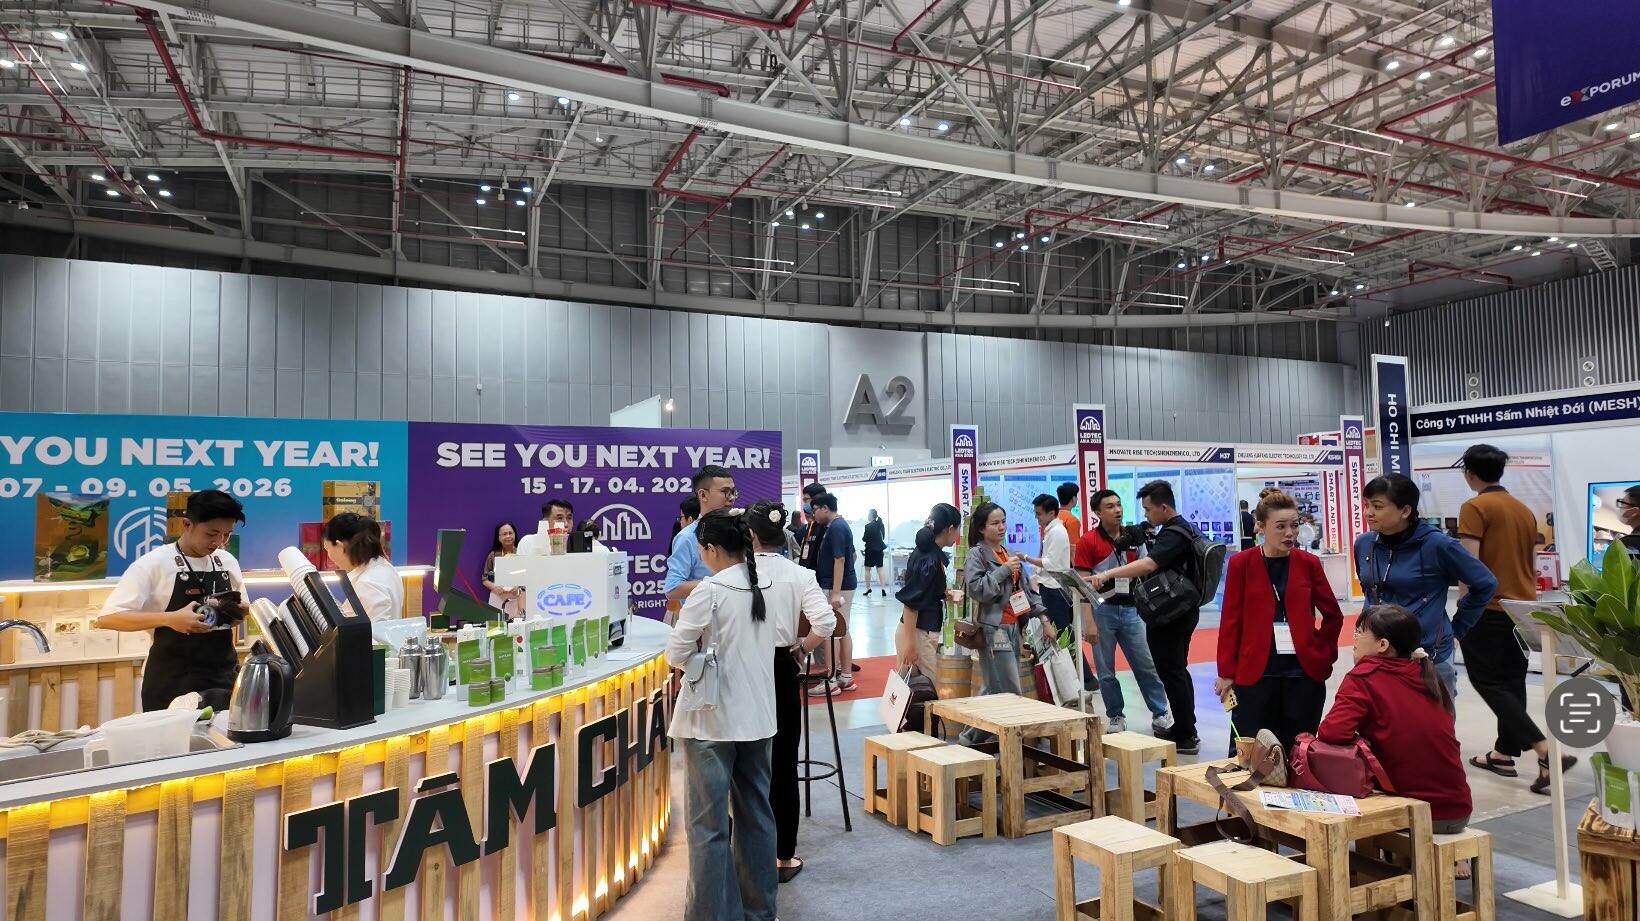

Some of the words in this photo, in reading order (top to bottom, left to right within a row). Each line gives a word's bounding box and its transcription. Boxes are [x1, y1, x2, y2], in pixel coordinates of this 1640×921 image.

[842, 373, 915, 427] A2
[1387, 393, 1398, 418] HO
[1416, 418, 1444, 429] Công
[1446, 416, 1457, 428] ty
[1458, 412, 1493, 425] TNHH
[1495, 407, 1522, 422] Sấm
[1525, 404, 1560, 419] Nhiệt
[1562, 401, 1585, 415] Đới
[1389, 421, 1400, 450] CHI
[0, 436, 108, 466] YOU
[121, 437, 244, 467] NEXT
[253, 440, 380, 467] YEAR!
[436, 441, 507, 468] SEE
[514, 443, 588, 468] YOU
[596, 444, 679, 468] NEXT
[685, 446, 771, 469] YEAR!
[0, 477, 43, 498] 07
[80, 477, 137, 498] 09.
[212, 477, 292, 497] 2026
[521, 477, 547, 494] 15
[569, 477, 601, 494] 17.
[607, 477, 645, 494] 04.
[651, 477, 693, 493] 202
[961, 468, 970, 506] SMART
[1351, 461, 1359, 499] SMART
[1353, 503, 1361, 528] AND
[543, 593, 585, 607] CAFE
